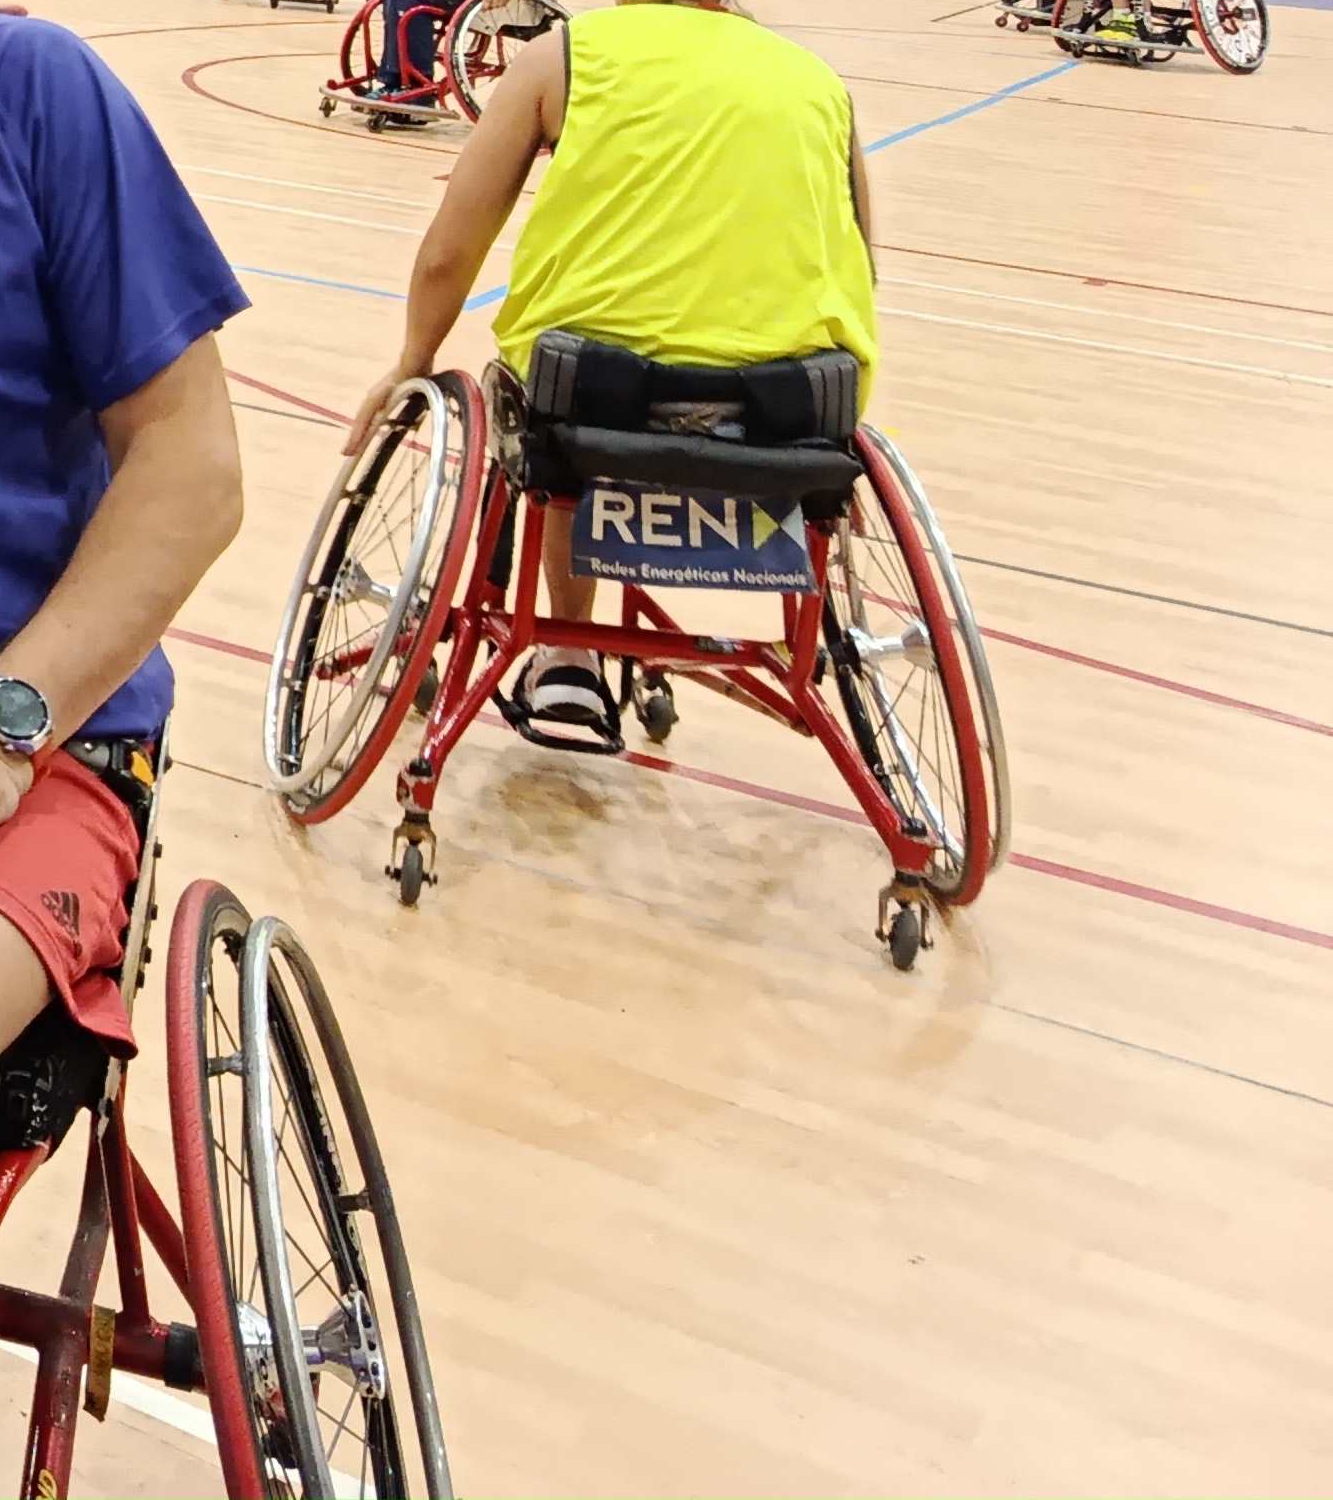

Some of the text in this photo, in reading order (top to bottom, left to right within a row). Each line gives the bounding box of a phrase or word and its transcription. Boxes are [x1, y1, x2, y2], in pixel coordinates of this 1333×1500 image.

[591, 489, 740, 550] REN
[590, 556, 637, 577] Redes
[733, 568, 808, 587] Nacionais
